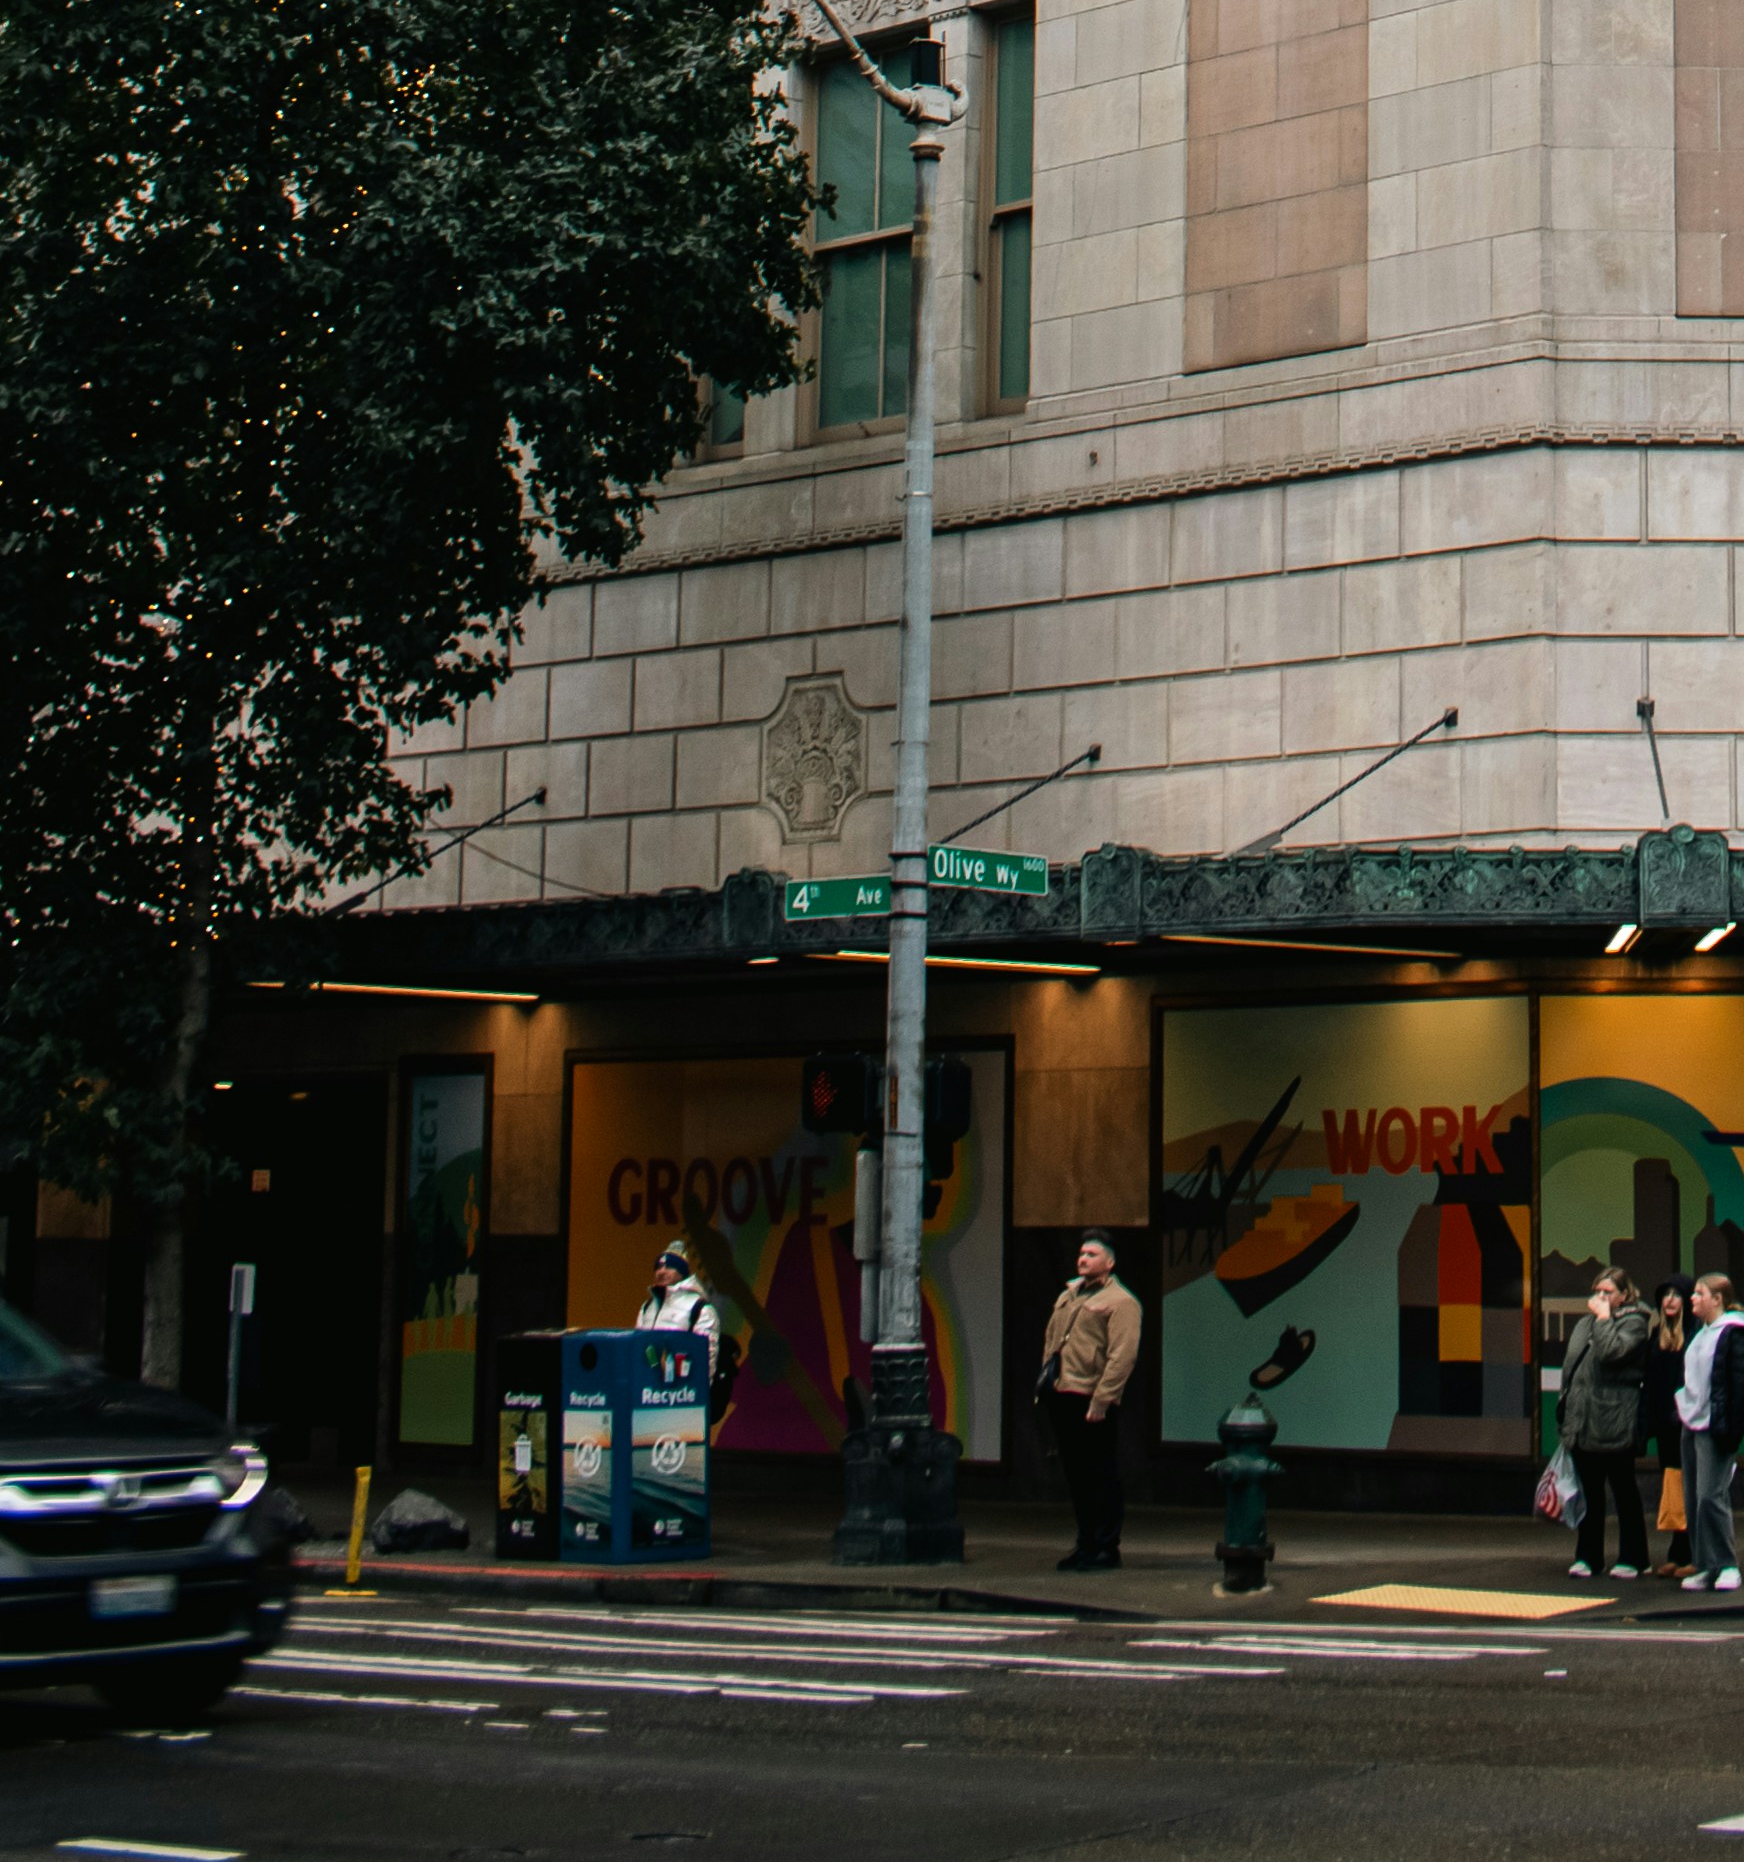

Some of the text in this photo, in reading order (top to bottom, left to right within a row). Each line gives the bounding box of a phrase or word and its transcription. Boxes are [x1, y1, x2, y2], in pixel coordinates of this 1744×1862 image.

[934, 848, 1019, 891] Olive Wy
[1023, 857, 1045, 873] 1600
[792, 883, 882, 914] 4th Ave
[1322, 1104, 1505, 1176] WORK
[607, 1156, 829, 1226] GROOVE
[504, 1390, 543, 1408] Garbage
[569, 1391, 606, 1408] Recycle
[641, 1386, 697, 1407] Recycle
